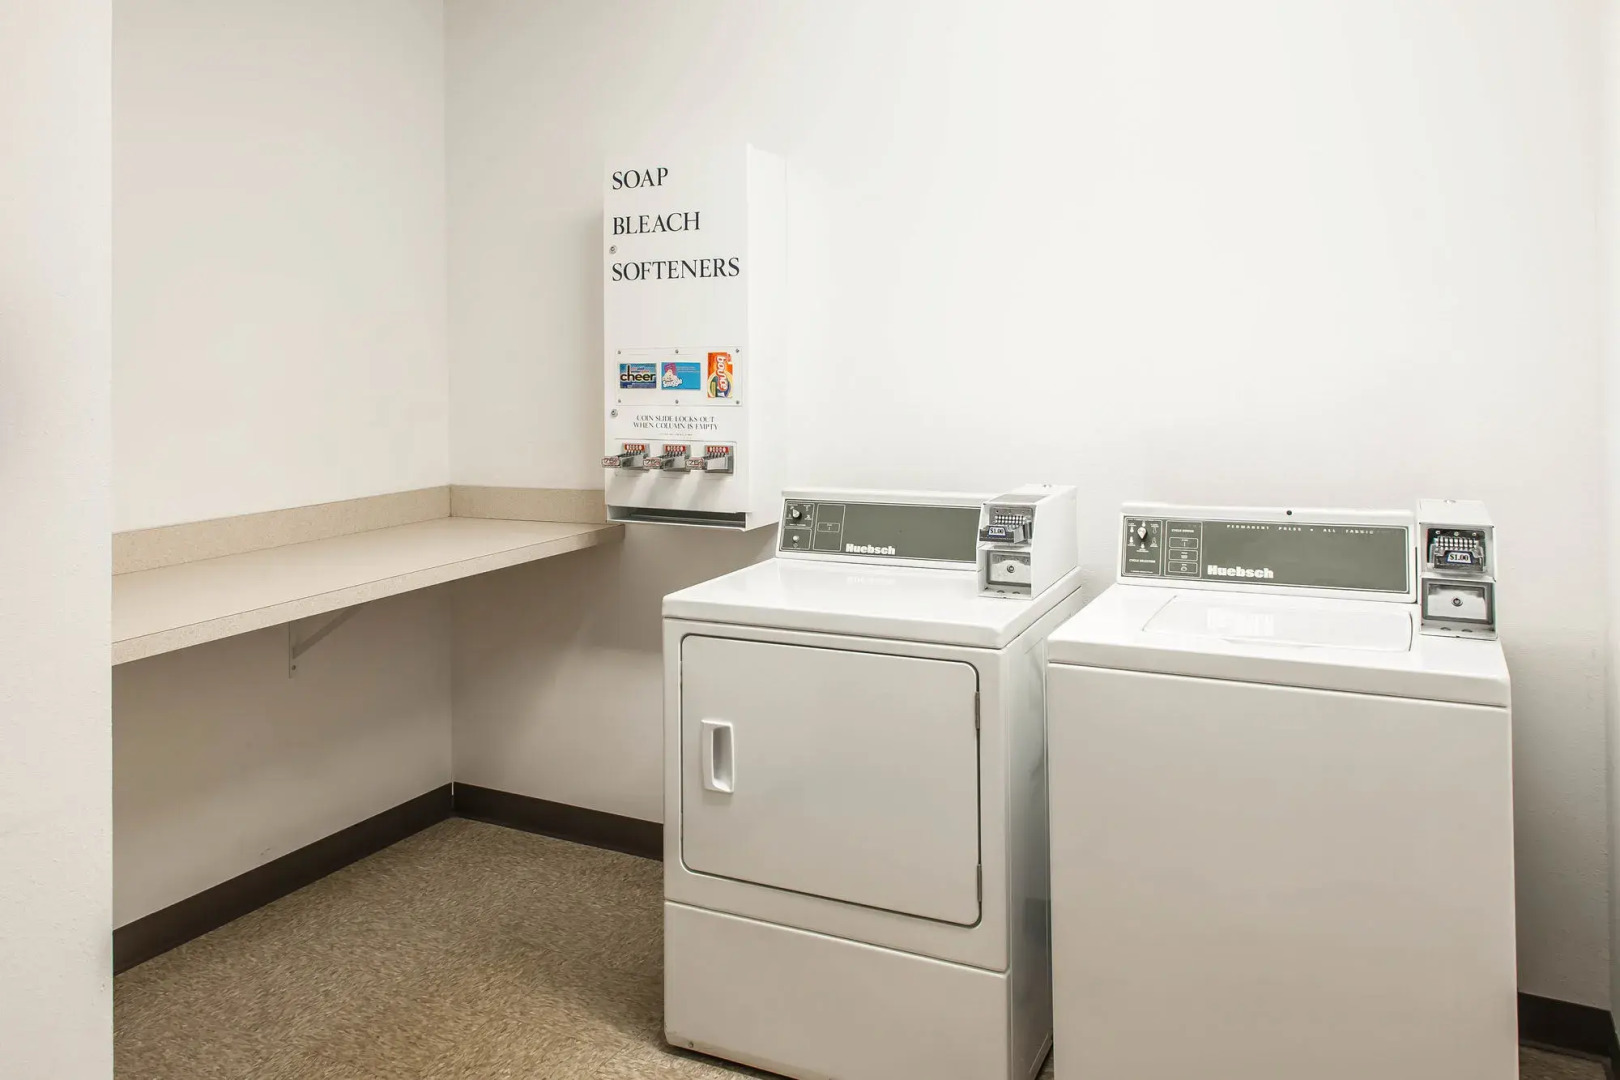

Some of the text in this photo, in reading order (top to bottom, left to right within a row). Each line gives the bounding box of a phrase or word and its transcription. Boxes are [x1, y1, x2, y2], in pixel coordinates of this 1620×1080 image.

[611, 167, 669, 190] SOAP
[612, 211, 701, 236] BLEACH
[611, 257, 740, 282] SOFTENERS
[620, 364, 656, 382] cheer
[636, 414, 654, 422] COIN
[845, 543, 896, 556] Huebsch
[1449, 552, 1469, 562] $1.00
[1207, 564, 1274, 580] Huebsch
